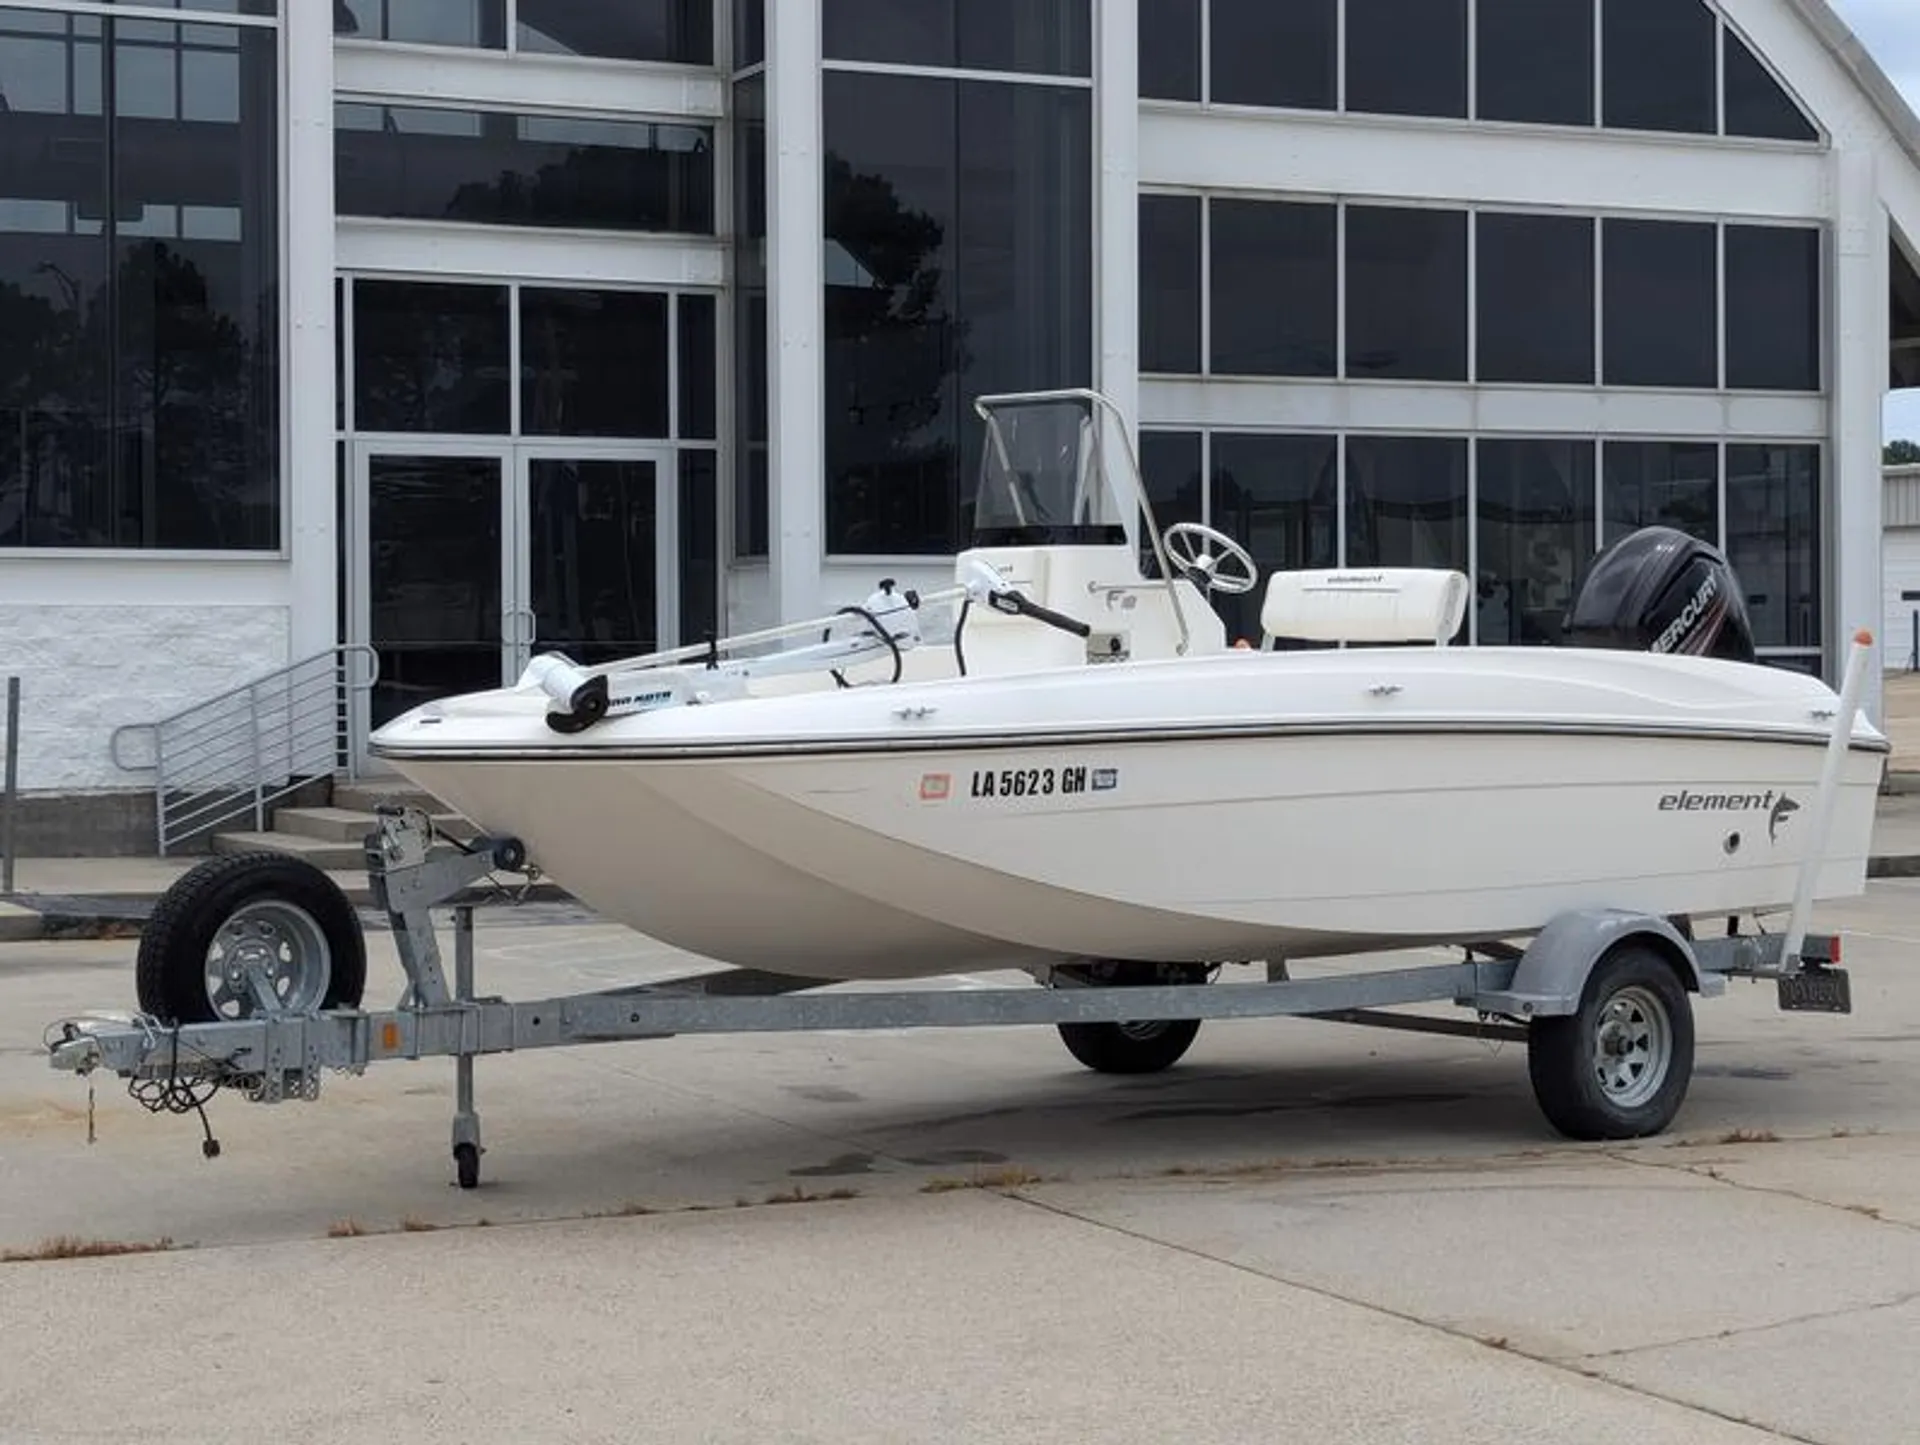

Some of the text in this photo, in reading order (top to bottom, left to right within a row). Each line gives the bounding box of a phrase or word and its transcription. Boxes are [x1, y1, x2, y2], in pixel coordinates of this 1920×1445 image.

[971, 770, 994, 797] LA
[1000, 768, 1054, 796] 5623
[1062, 766, 1086, 794] GH
[1658, 789, 1772, 810] element
